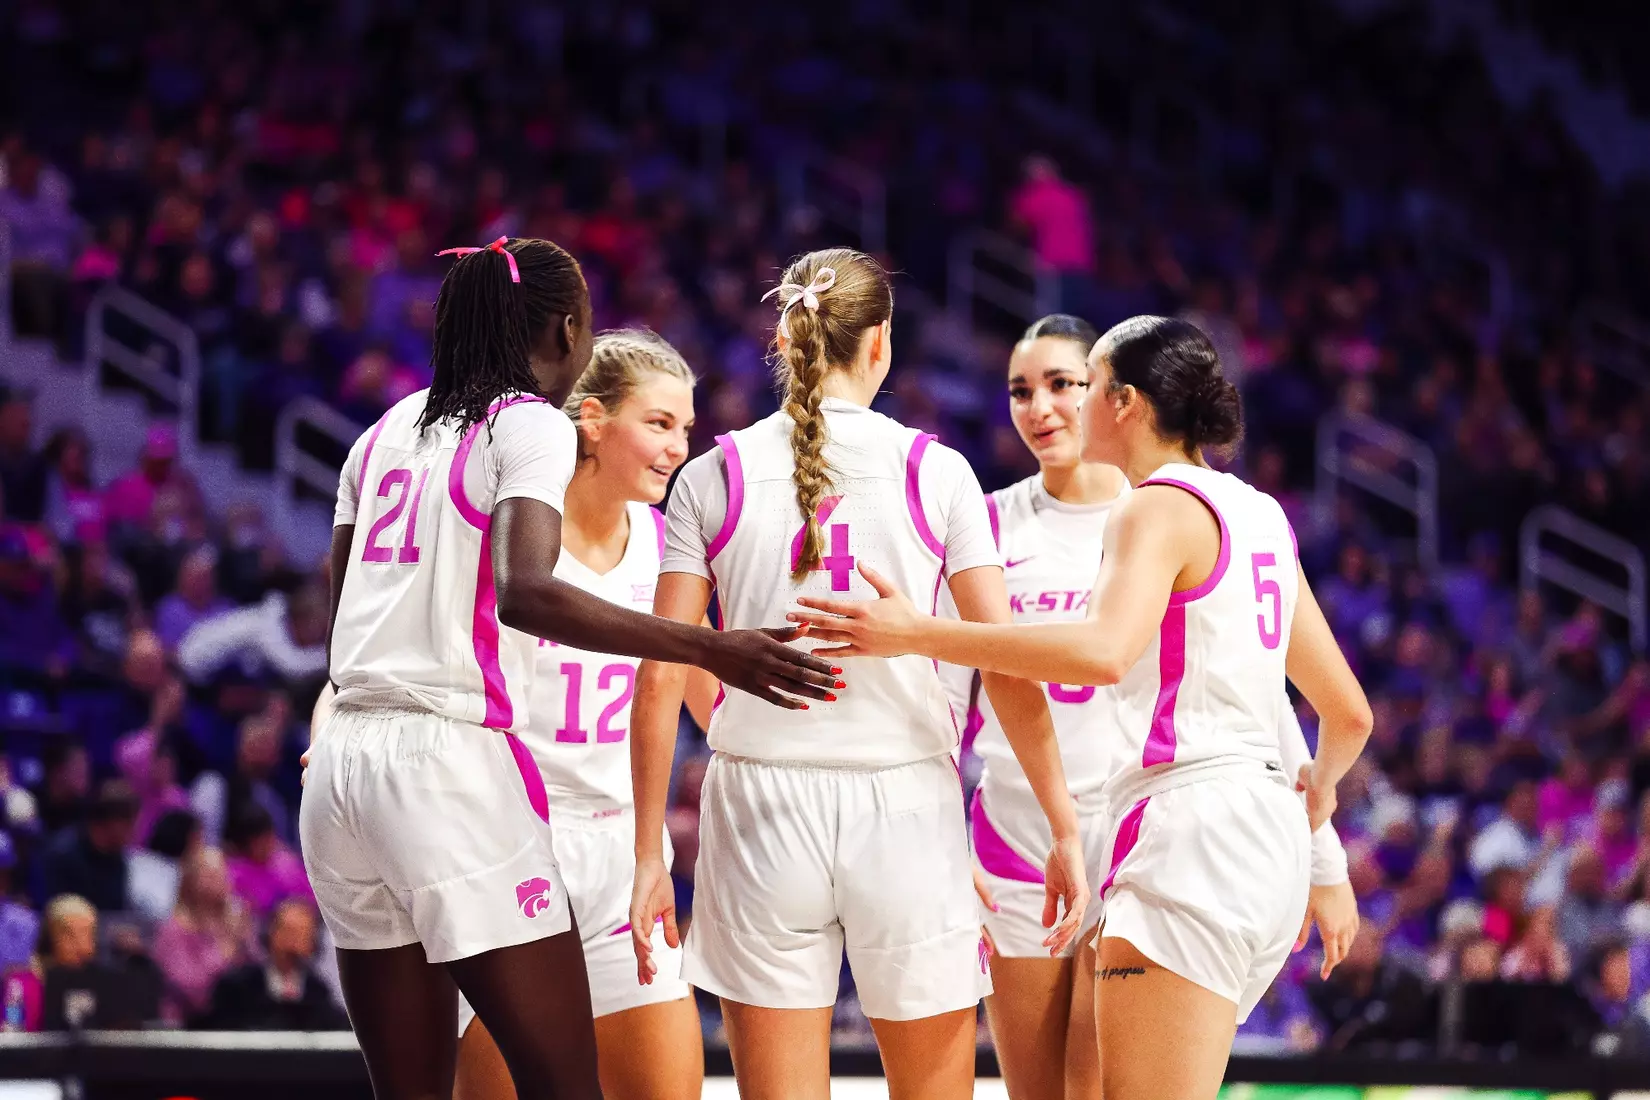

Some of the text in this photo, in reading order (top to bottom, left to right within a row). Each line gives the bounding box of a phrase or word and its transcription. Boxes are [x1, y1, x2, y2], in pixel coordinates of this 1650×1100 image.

[362, 468, 430, 563] 21
[791, 494, 854, 591] 4
[1251, 552, 1281, 649] 5
[556, 662, 637, 743] 12
[1107, 967, 1146, 980] progress
